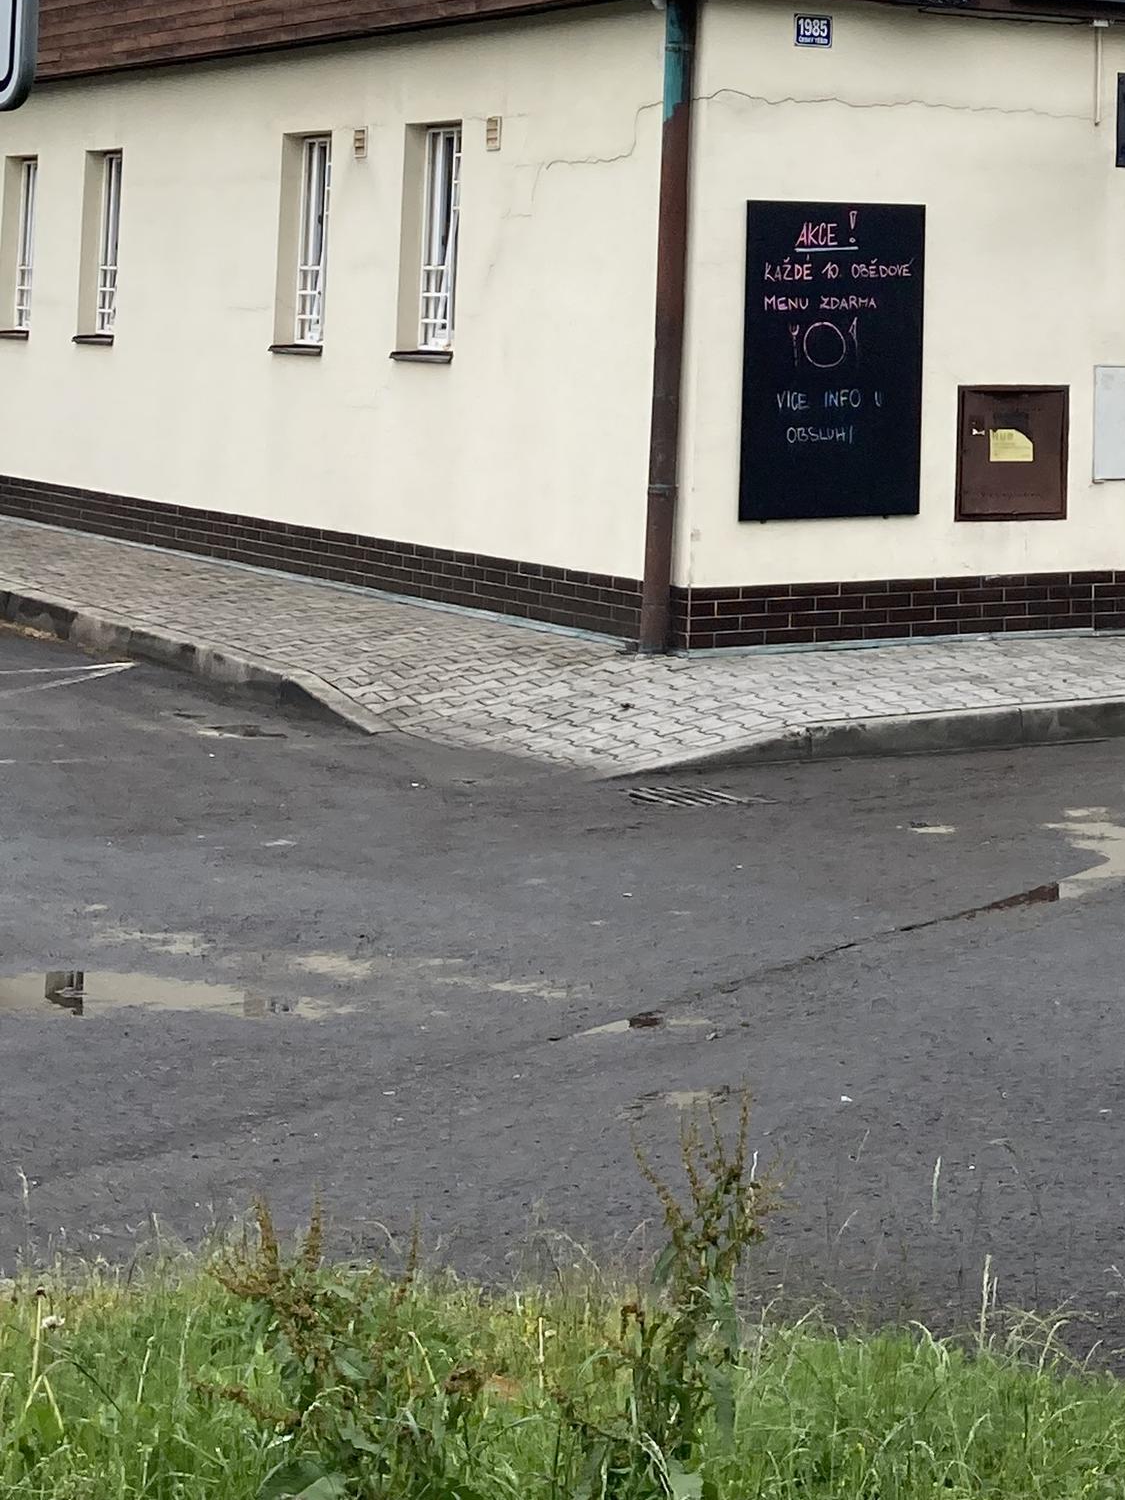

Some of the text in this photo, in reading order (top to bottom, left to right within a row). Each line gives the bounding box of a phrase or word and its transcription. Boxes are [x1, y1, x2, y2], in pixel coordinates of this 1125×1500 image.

[798, 18, 828, 37] 1985
[764, 254, 813, 282] KAŽDÉ
[764, 295, 877, 311] MENU ZDARMA
[824, 389, 861, 408] INFO
